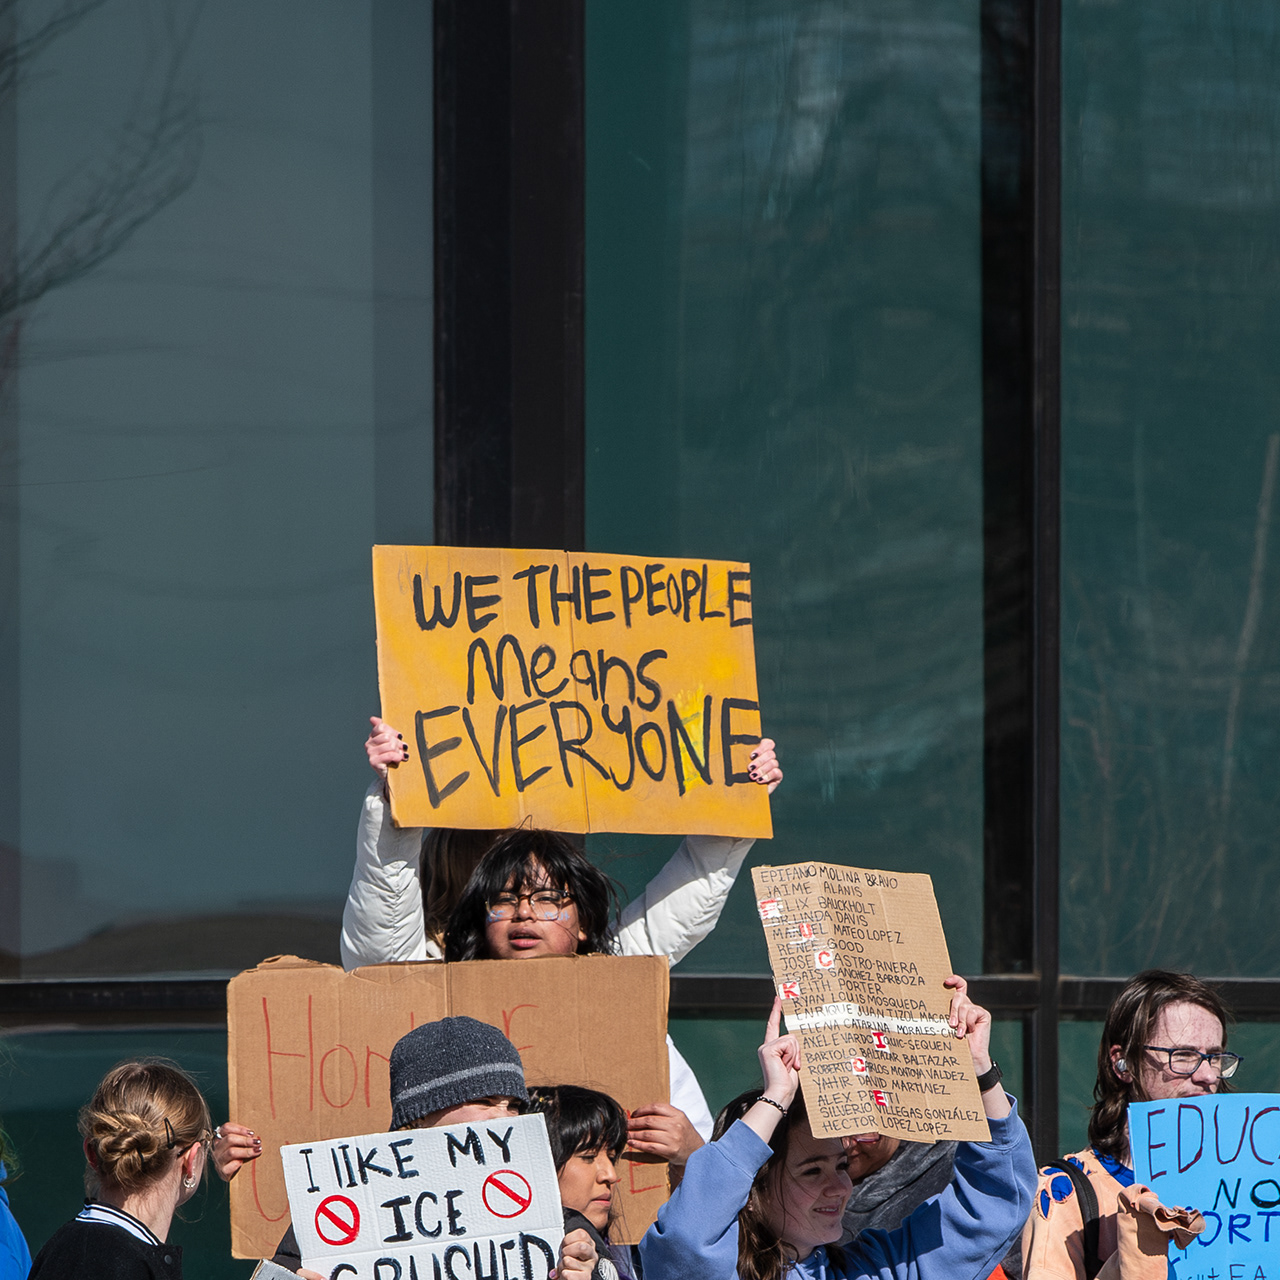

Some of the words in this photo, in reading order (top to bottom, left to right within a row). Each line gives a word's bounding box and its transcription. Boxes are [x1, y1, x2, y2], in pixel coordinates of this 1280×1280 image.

[413, 571, 502, 632] WE
[512, 562, 616, 628] THE
[620, 564, 752, 628] PEOPLE
[415, 695, 761, 809] EVERYONE
[761, 865, 816, 882] EPIFANO
[820, 867, 860, 883] MOLINA
[865, 873, 898, 889] BRAVO
[766, 882, 812, 898] JAIME
[824, 881, 862, 897] ALANIS
[836, 912, 868, 927] DAVIS
[834, 925, 864, 939] MATEO
[868, 929, 904, 944] LOPEZ
[827, 938, 864, 953] GOOD
[780, 955, 813, 971] JOSE
[877, 973, 925, 985] BARBOZA
[782, 980, 832, 999] KEITH
[840, 979, 884, 995] PORTER
[792, 993, 826, 1008] RYAN
[832, 991, 865, 1004] LOUIS
[867, 995, 927, 1011] MOSQUEDA
[795, 1003, 852, 1020] ENRIQUE
[800, 1020, 840, 1035] ELENA
[803, 1034, 830, 1049] AXEL
[263, 995, 416, 1119] Hon
[805, 1048, 856, 1063] BARTOLO
[902, 1054, 960, 1066] BALTAZAR
[808, 1061, 852, 1075] ROBERTO
[926, 1069, 969, 1081] VALDEZ
[858, 1075, 887, 1088] DAVID
[818, 1092, 852, 1106] ALEX
[820, 1102, 873, 1118] SILVERIO
[874, 1104, 922, 1119] VILLEGAS
[822, 1115, 878, 1132] HECTOR
[880, 1116, 915, 1132] LOPEZ
[916, 1121, 952, 1135] LOPEZ
[299, 1148, 320, 1193] I
[444, 1126, 514, 1168] MY
[380, 1189, 467, 1243] ICE
